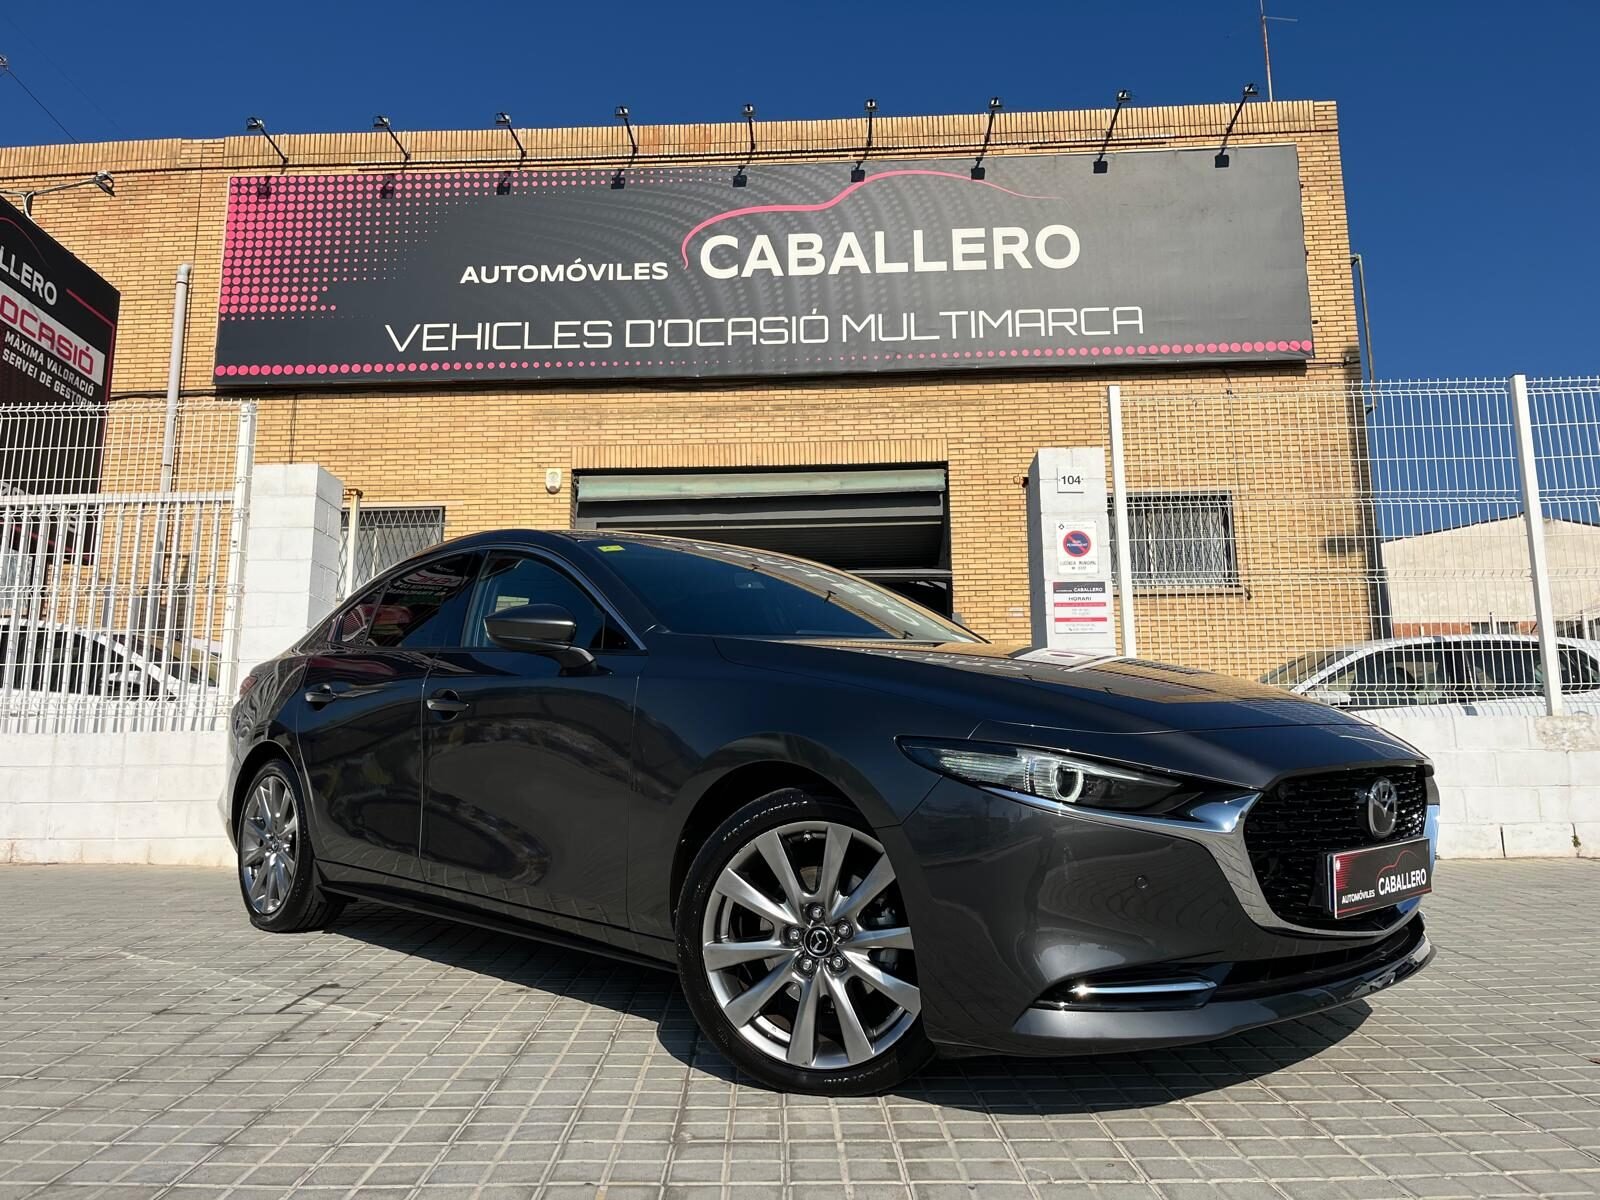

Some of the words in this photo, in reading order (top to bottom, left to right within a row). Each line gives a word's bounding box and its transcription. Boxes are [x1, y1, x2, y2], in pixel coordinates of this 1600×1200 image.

[459, 257, 669, 285] AUTOMÓVILES
[699, 224, 1081, 280] CABALLERO
[384, 320, 613, 352] VEHICLES
[625, 308, 829, 348] D'OCASIÓ
[842, 306, 1144, 343] MULTIMARCA
[2, 348, 38, 379] SERVEI
[39, 371, 53, 388] DE
[46, 357, 95, 397] VALORACIÓ
[1061, 475, 1082, 485] 104
[1378, 868, 1427, 896] CABALLERO
